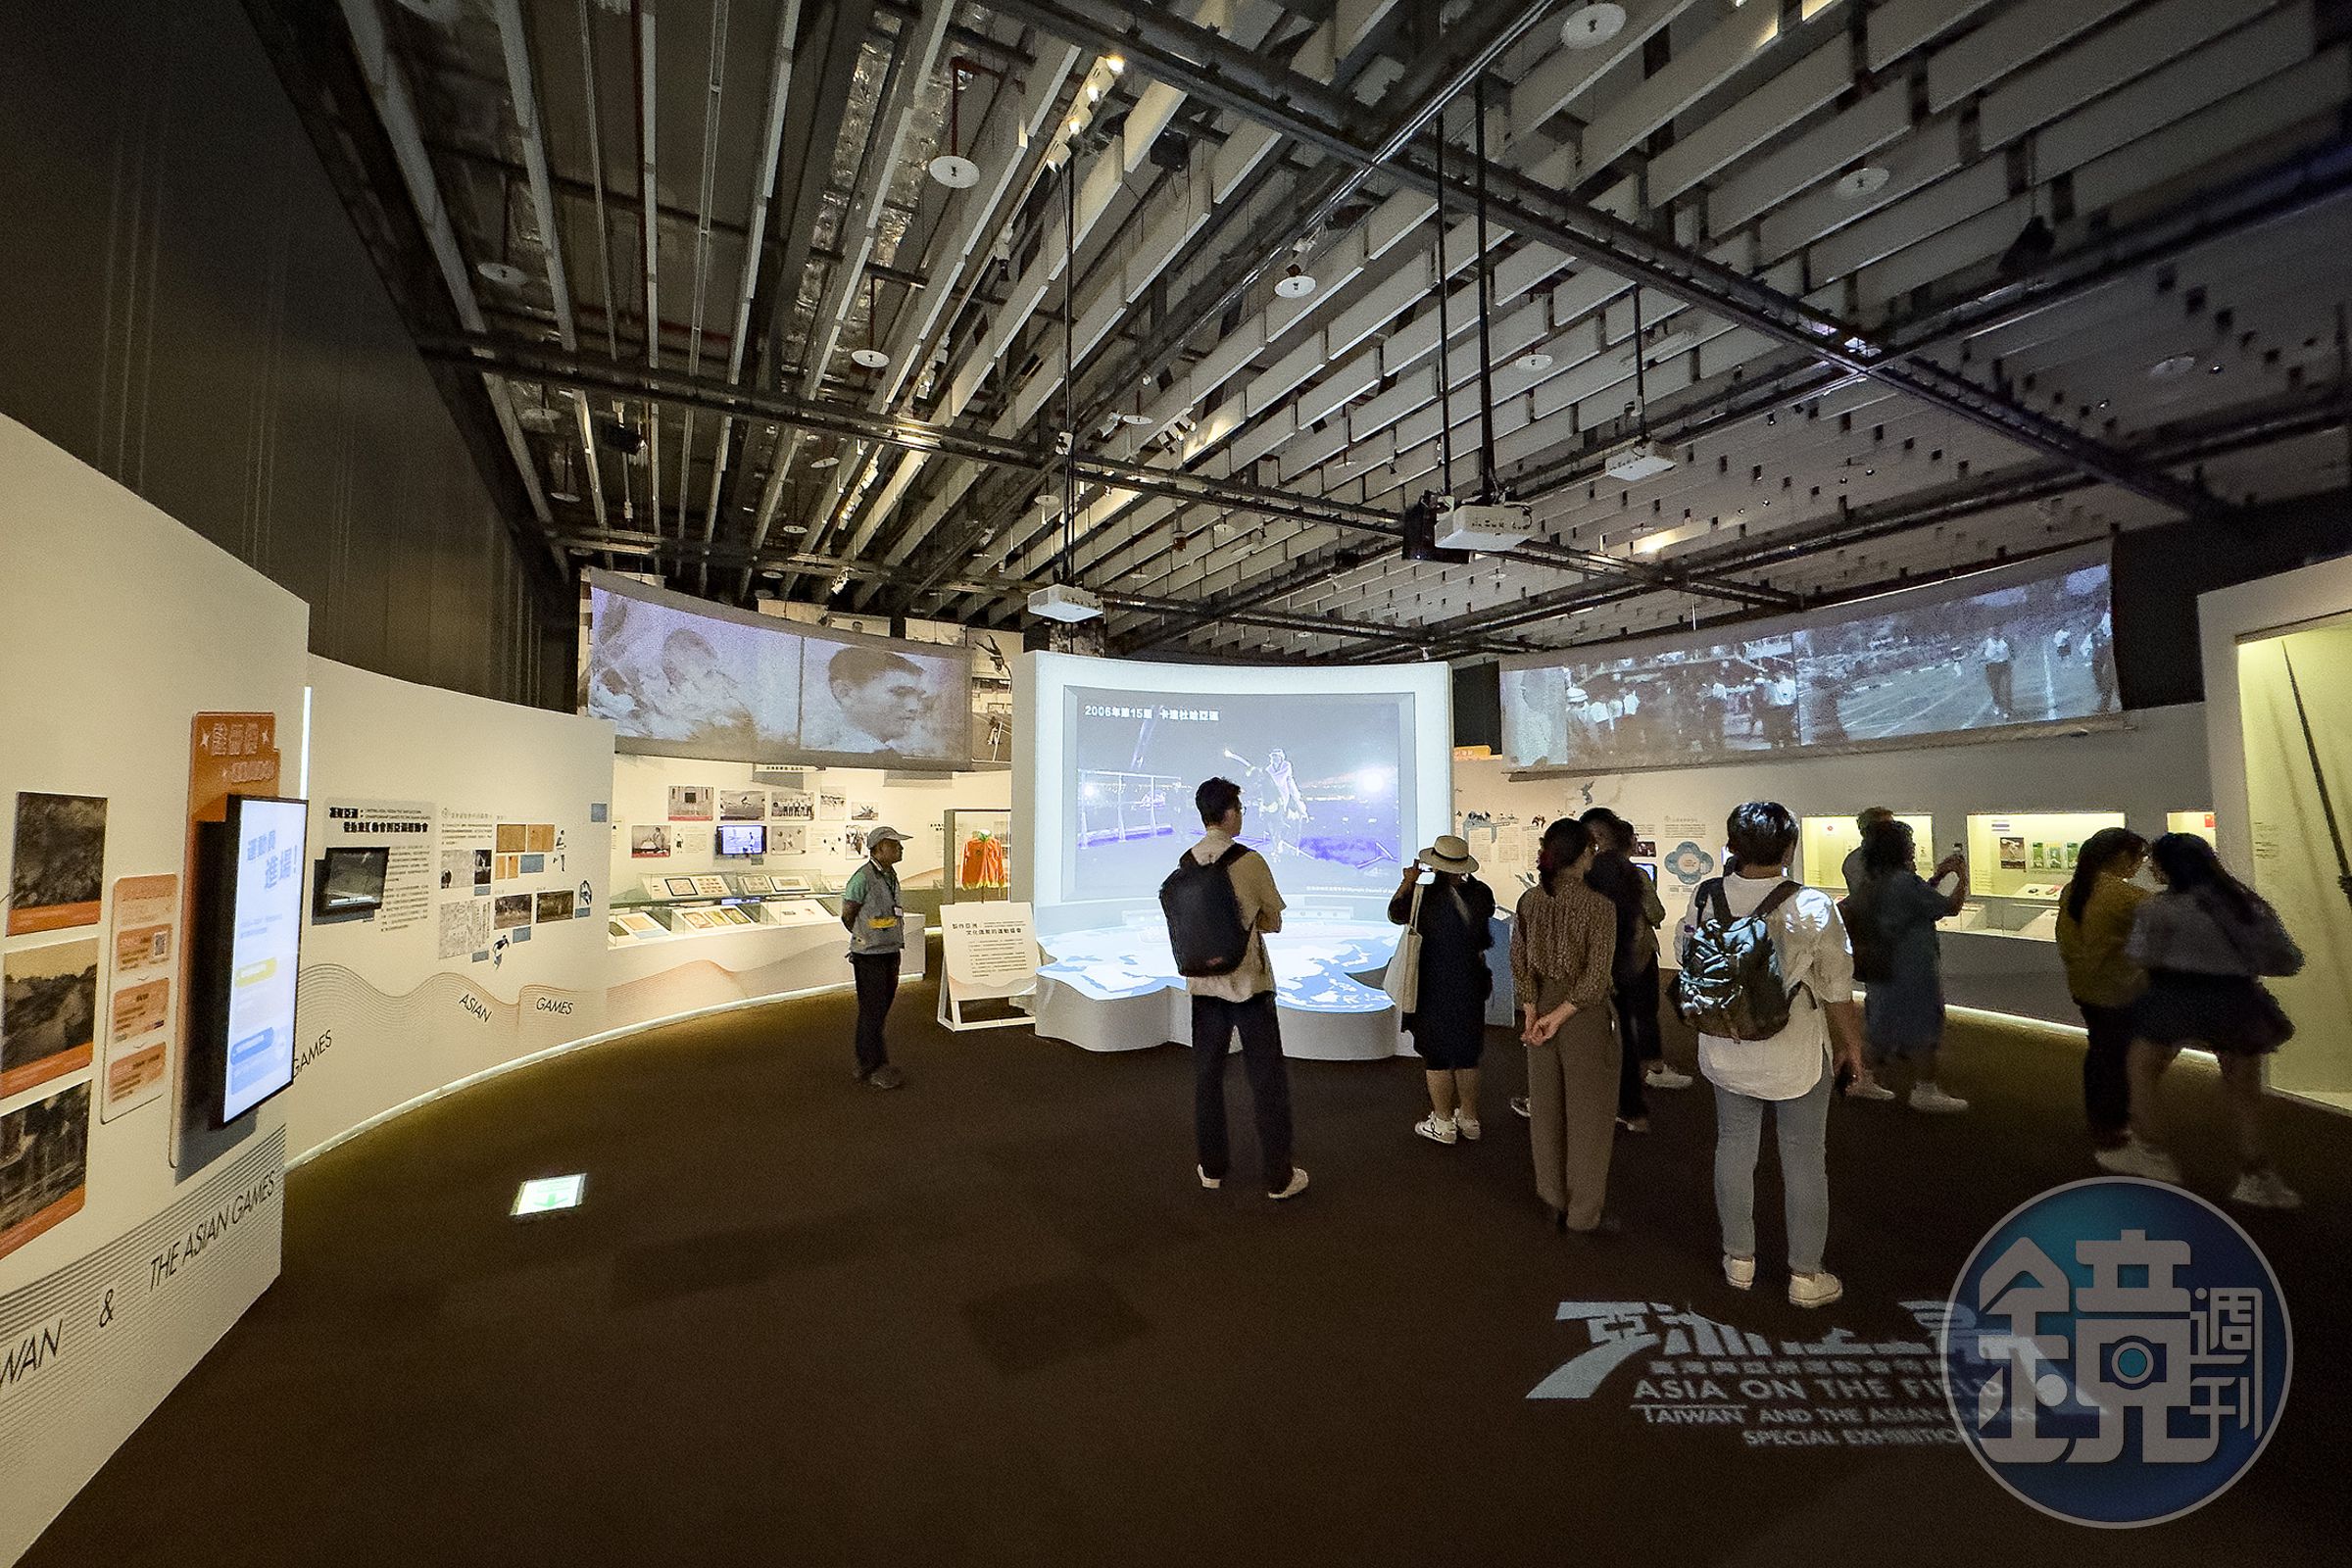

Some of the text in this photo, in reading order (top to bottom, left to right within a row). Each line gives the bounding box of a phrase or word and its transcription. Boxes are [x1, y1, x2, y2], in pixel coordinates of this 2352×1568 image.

[459, 993, 574, 1022] ASIAN GAMES
[99, 1288, 115, 1328] &
[150, 1241, 180, 1292] THE
[182, 1204, 228, 1266] ASIAN
[231, 1170, 275, 1225] GAMES
[1633, 1379, 1729, 1399] ASIA
[1739, 1379, 1806, 1399] ON
[1815, 1378, 1891, 1398] THE
[1630, 1404, 1748, 1423] TAIWAN
[1759, 1408, 1813, 1423] AND
[1815, 1407, 1863, 1422] THE
[1741, 1429, 1839, 1446] SPECIAL
